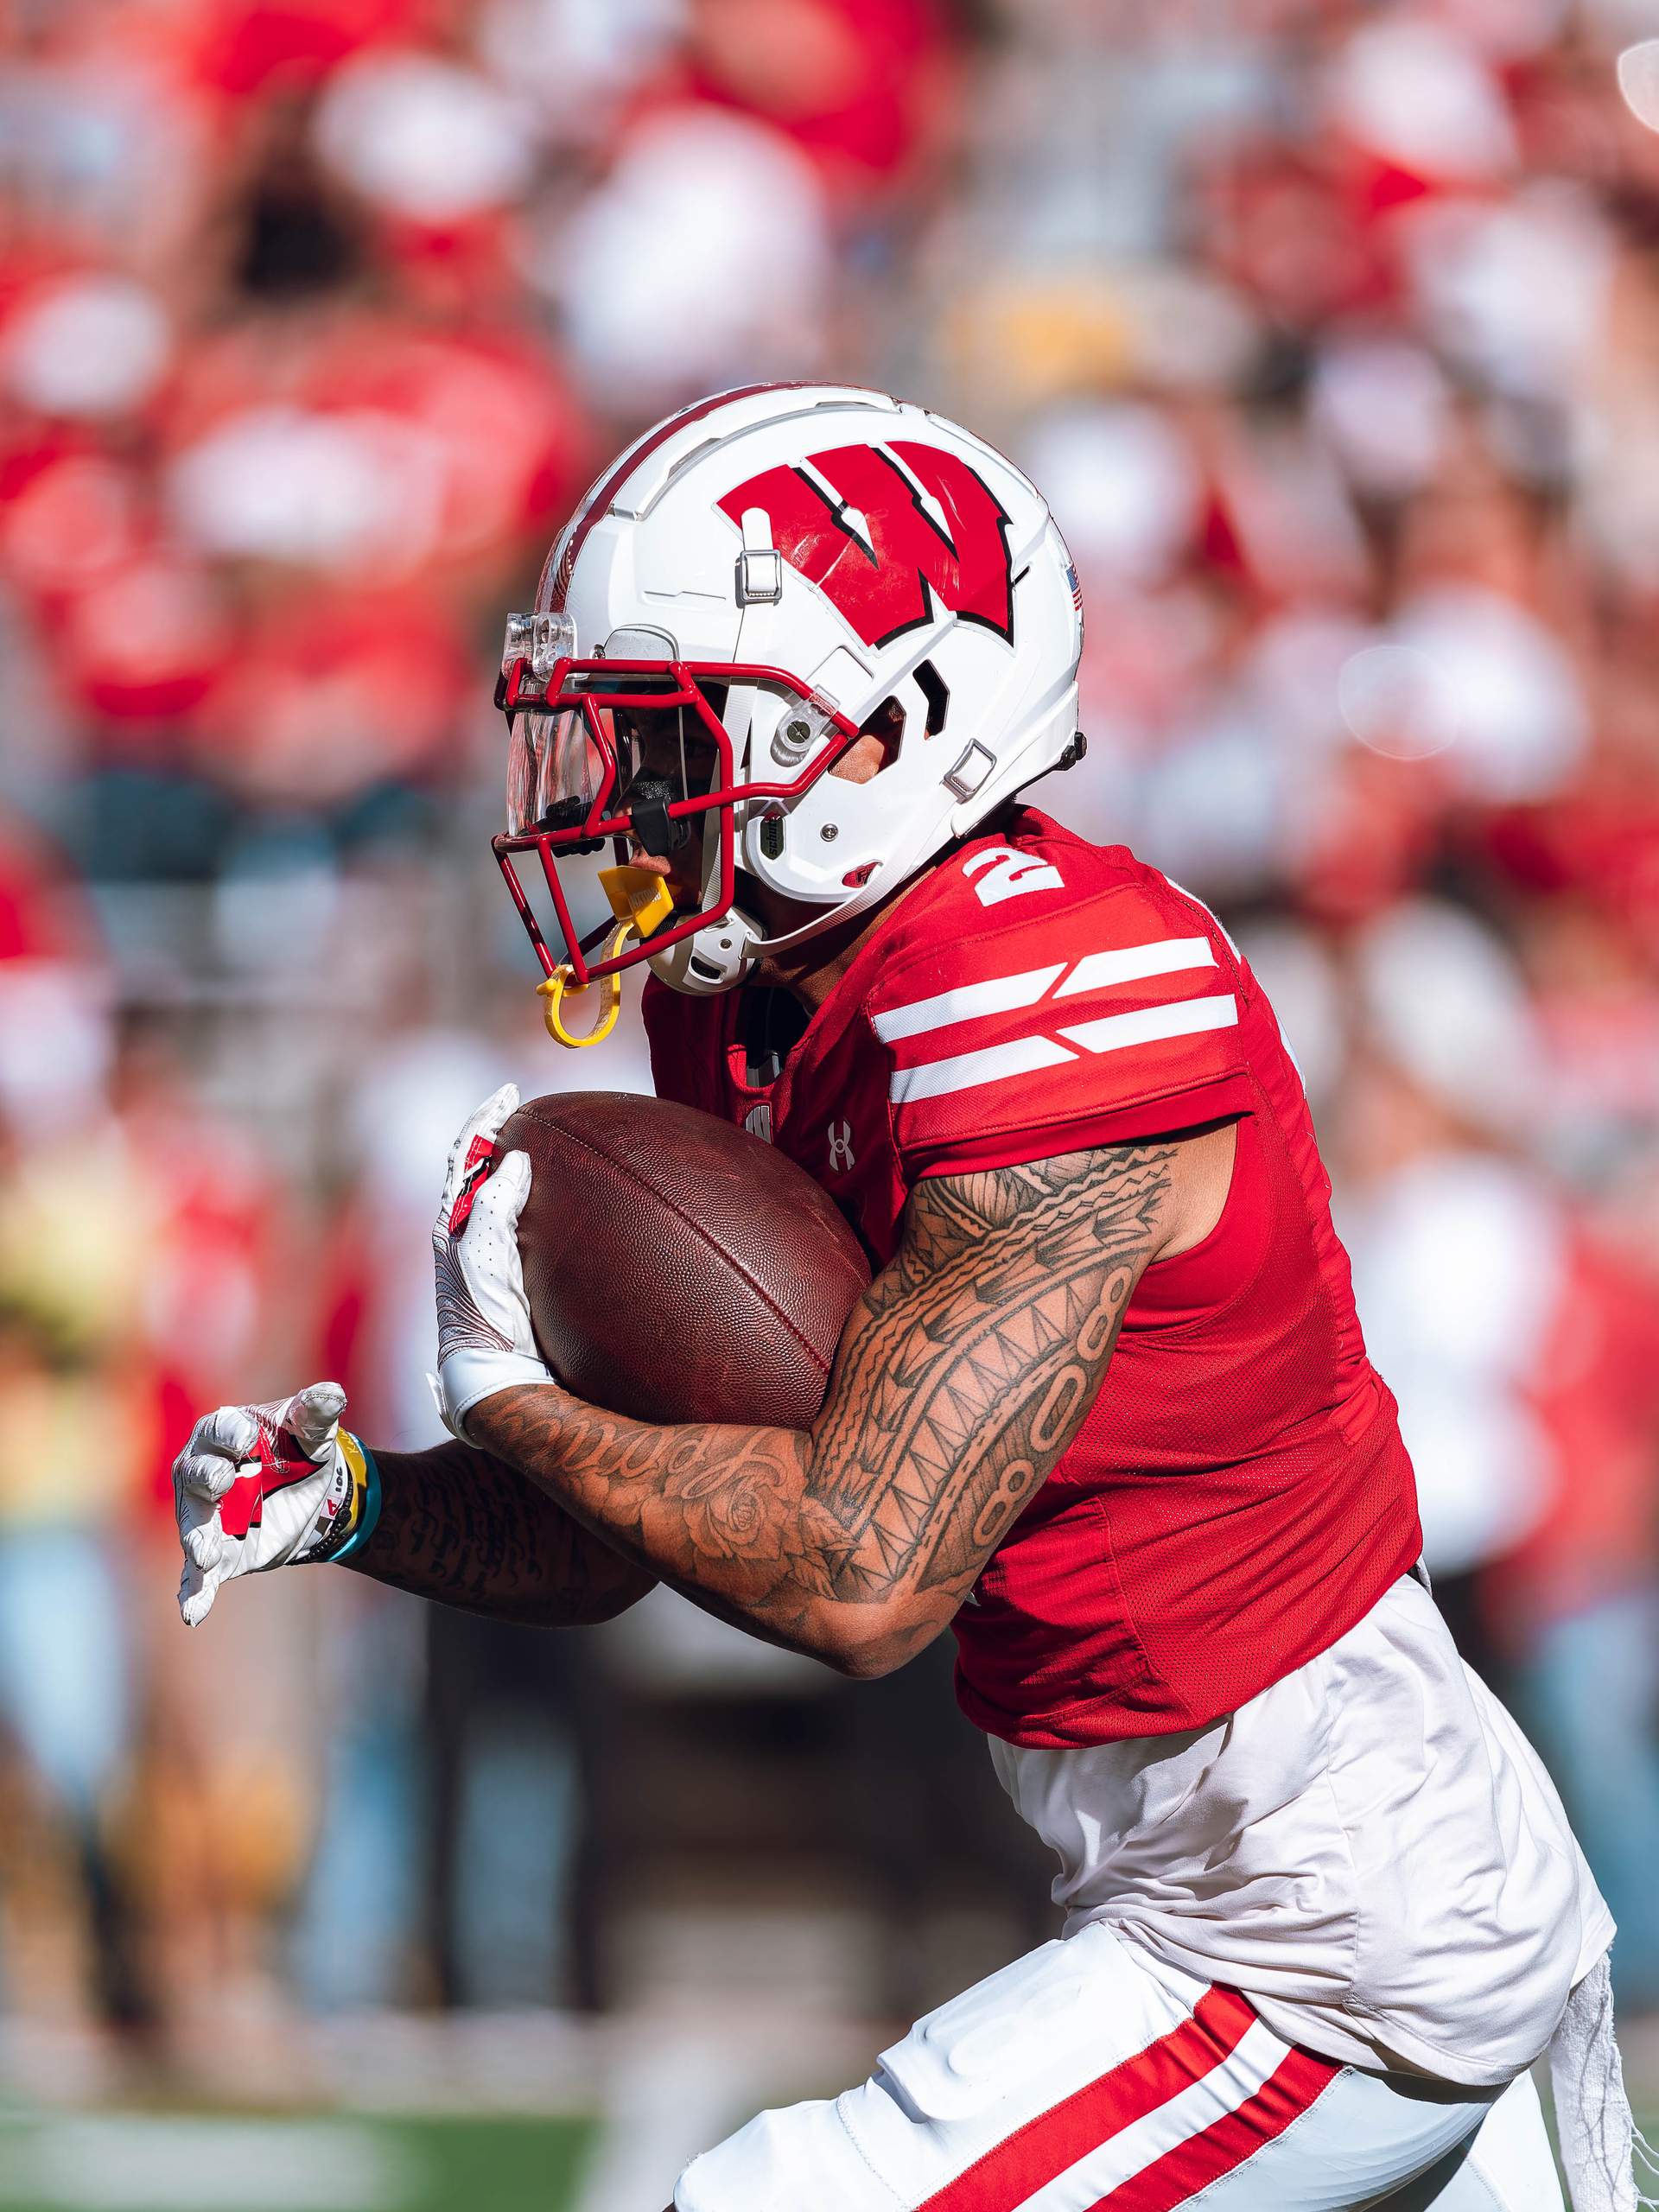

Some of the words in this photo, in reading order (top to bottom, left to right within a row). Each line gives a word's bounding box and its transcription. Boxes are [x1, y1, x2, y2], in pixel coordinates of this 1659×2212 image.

[712, 439, 1014, 652] W
[962, 847, 1065, 907] 2
[973, 1265, 1134, 1548] 808
